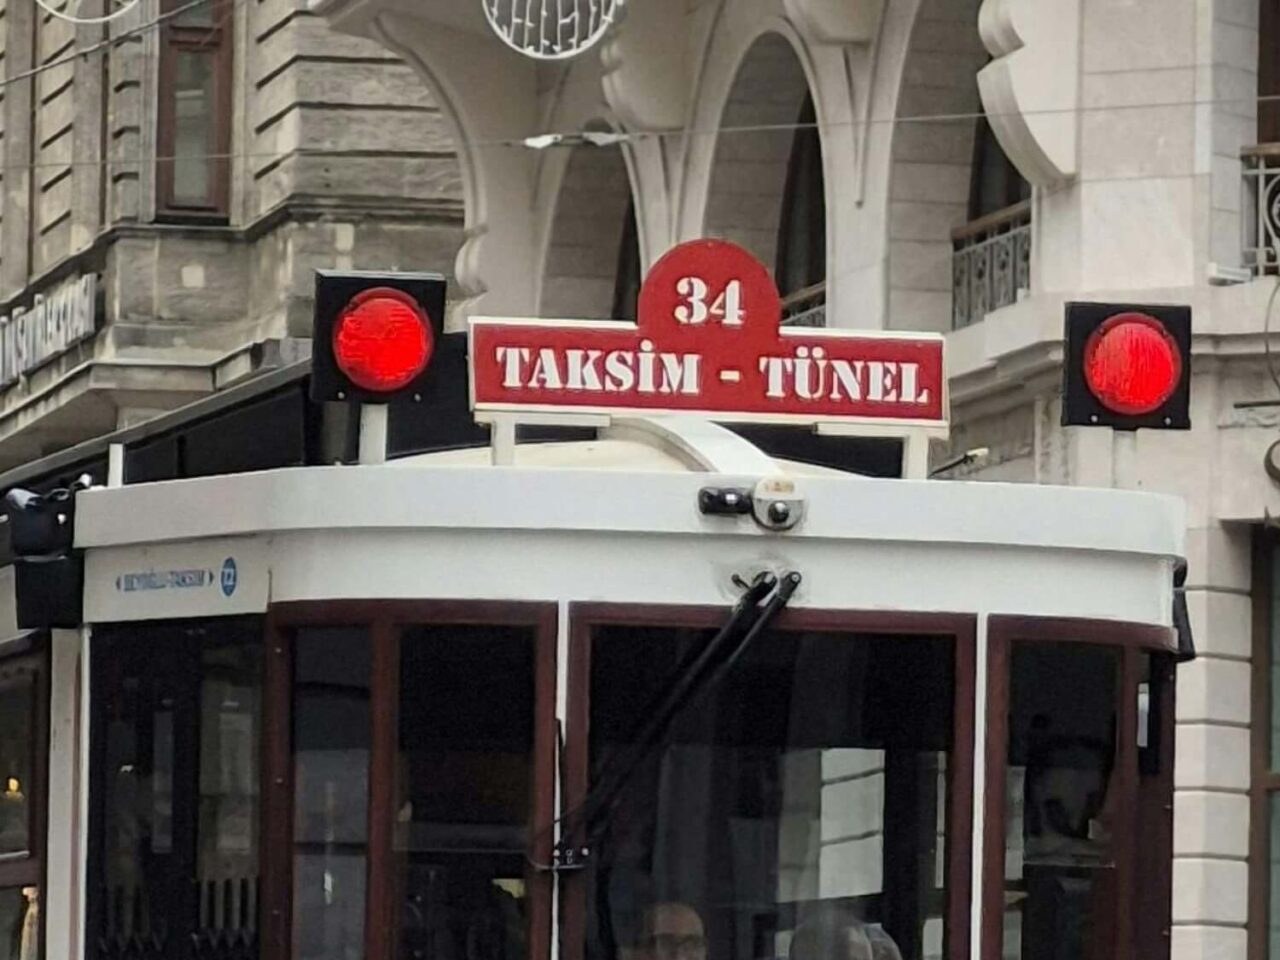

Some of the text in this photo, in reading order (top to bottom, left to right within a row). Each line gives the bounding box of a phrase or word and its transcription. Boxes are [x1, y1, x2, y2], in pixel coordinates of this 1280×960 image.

[674, 277, 745, 325] 34
[496, 340, 701, 394] TAKSİM
[759, 346, 929, 404] TÜNEL
